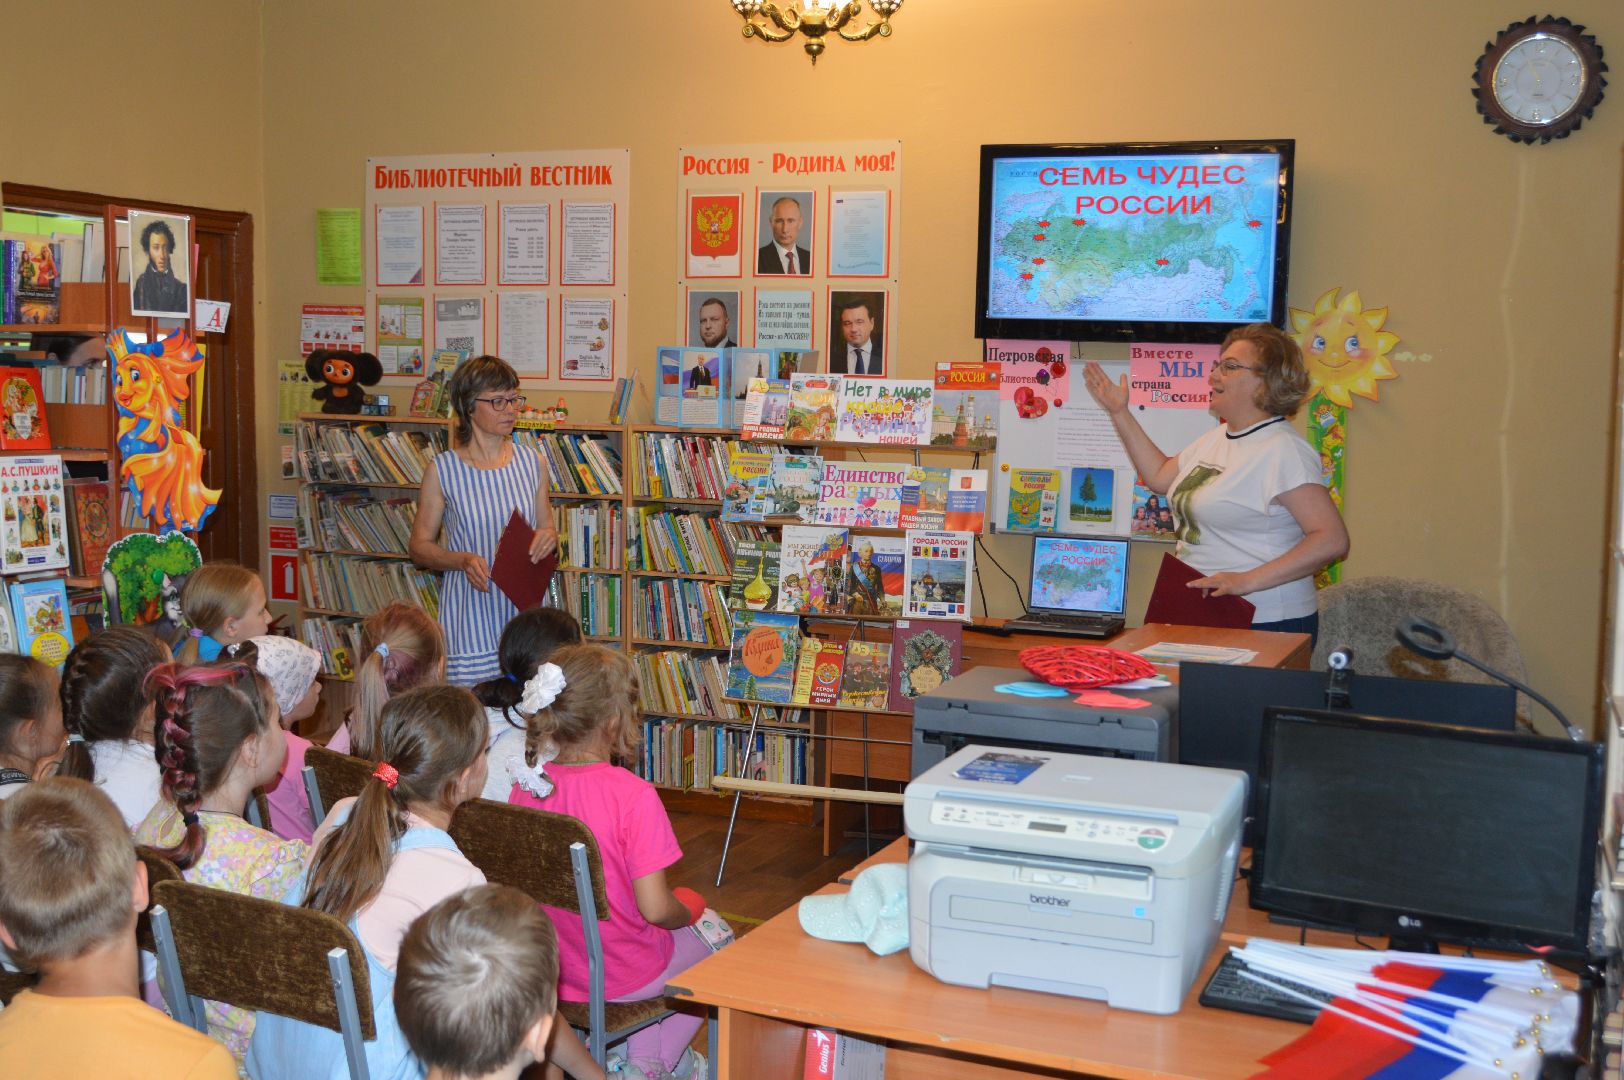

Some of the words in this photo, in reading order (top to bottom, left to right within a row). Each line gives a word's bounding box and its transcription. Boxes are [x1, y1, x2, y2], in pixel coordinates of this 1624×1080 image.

[1039, 166, 1127, 186] СЕМЬ
[1137, 165, 1245, 188] ЧУДЕС
[1076, 195, 1212, 215] РОССИИ
[1132, 347, 1193, 359] Вместе
[950, 371, 986, 383] РОССИЯ
[844, 379, 873, 397] Нет
[893, 386, 932, 401] мире
[1132, 380, 1171, 392] страна
[1151, 389, 1214, 403] Россия!
[879, 432, 918, 444] нашей
[1, 465, 58, 477] А.С.ПУШКИН
[820, 483, 902, 502] разных
[913, 537, 939, 545] ГОРОДА
[941, 538, 968, 546] РОССИИ
[1050, 542, 1079, 552] СЕМЬ
[1082, 543, 1117, 554] ЧУДЕС
[1061, 555, 1106, 565] РОССИИ
[1030, 893, 1071, 908] brother
[1409, 918, 1422, 927] LG
[819, 1044, 830, 1074] Genius
